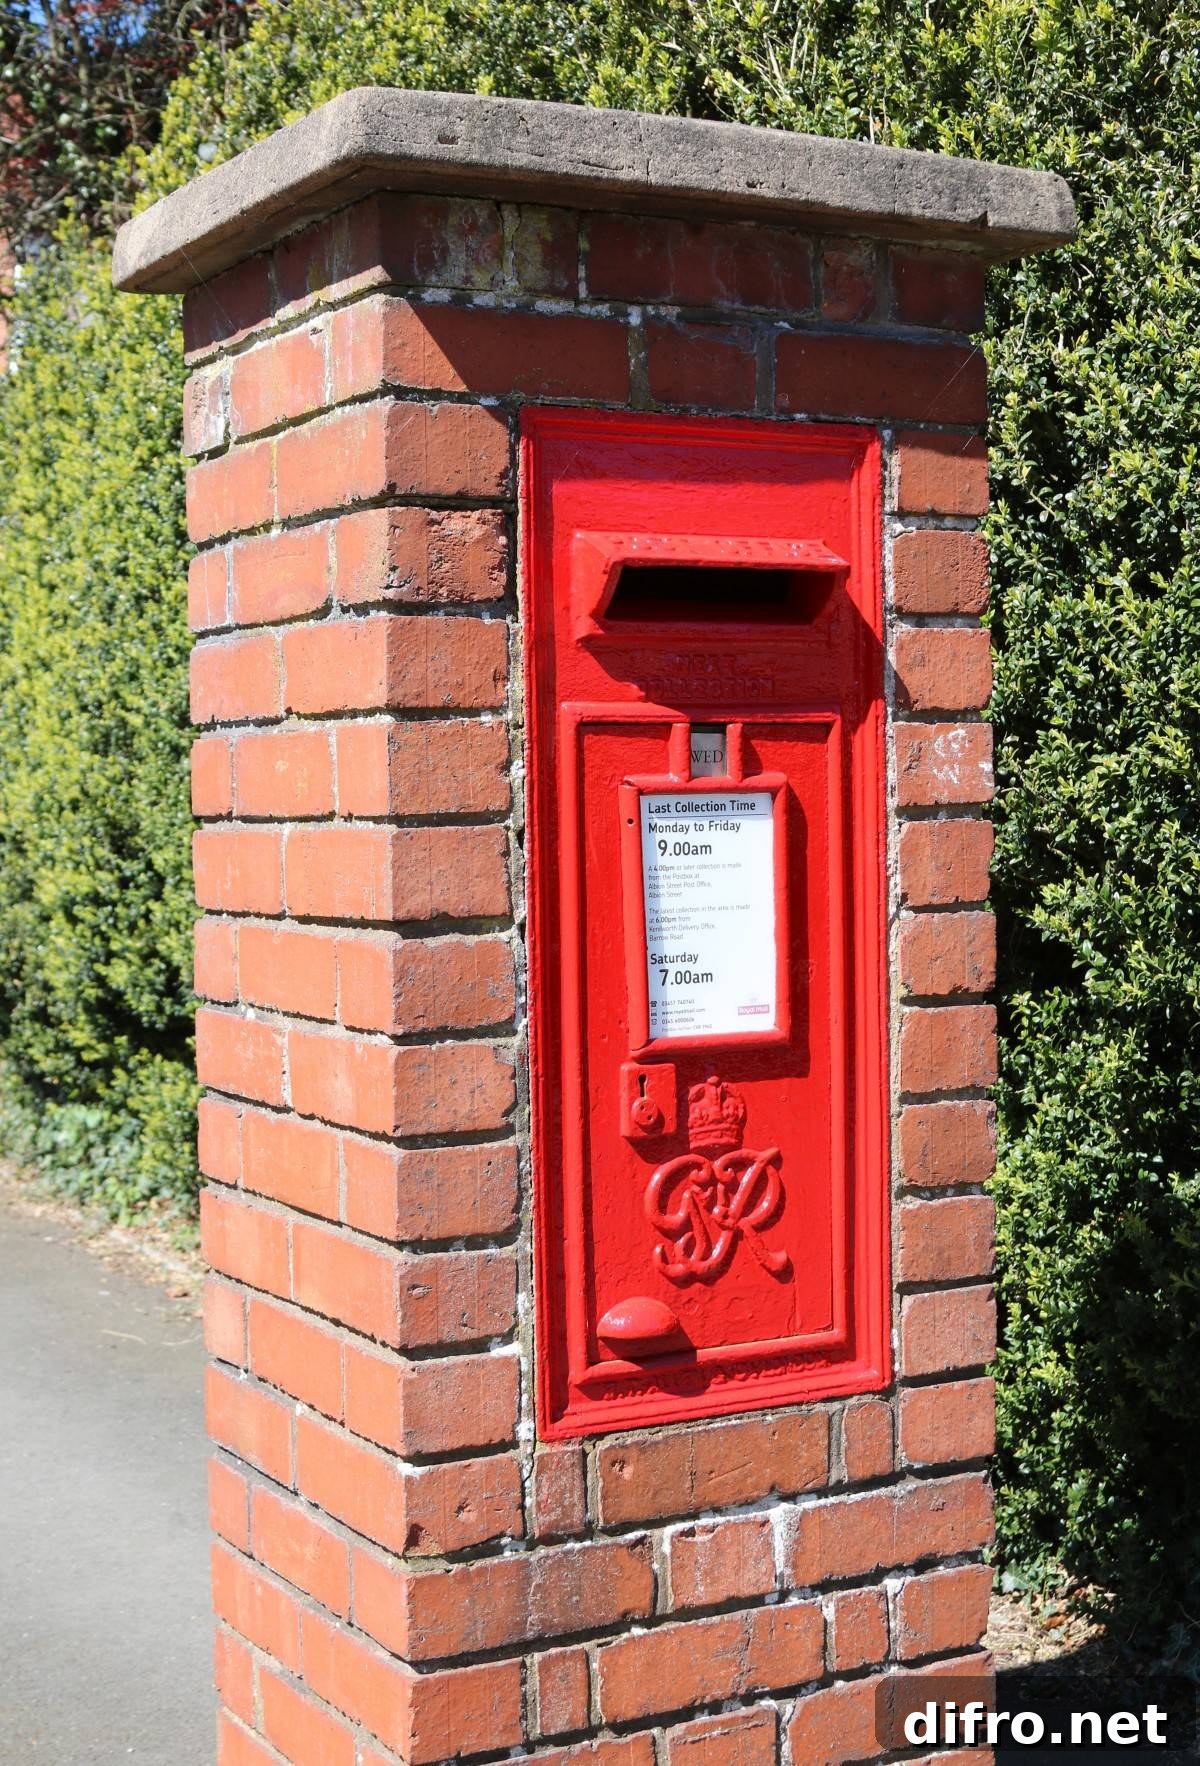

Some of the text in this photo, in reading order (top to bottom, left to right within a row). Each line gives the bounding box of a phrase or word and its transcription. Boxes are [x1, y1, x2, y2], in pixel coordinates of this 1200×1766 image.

[691, 750, 724, 764] WED
[648, 800, 756, 814] Last Collection Time
[648, 820, 742, 835] Monday to Friday
[658, 840, 712, 856] 9.00am
[655, 916, 677, 924] 6.00pm
[650, 952, 699, 965] Saturday
[659, 969, 713, 986] 7.00am
